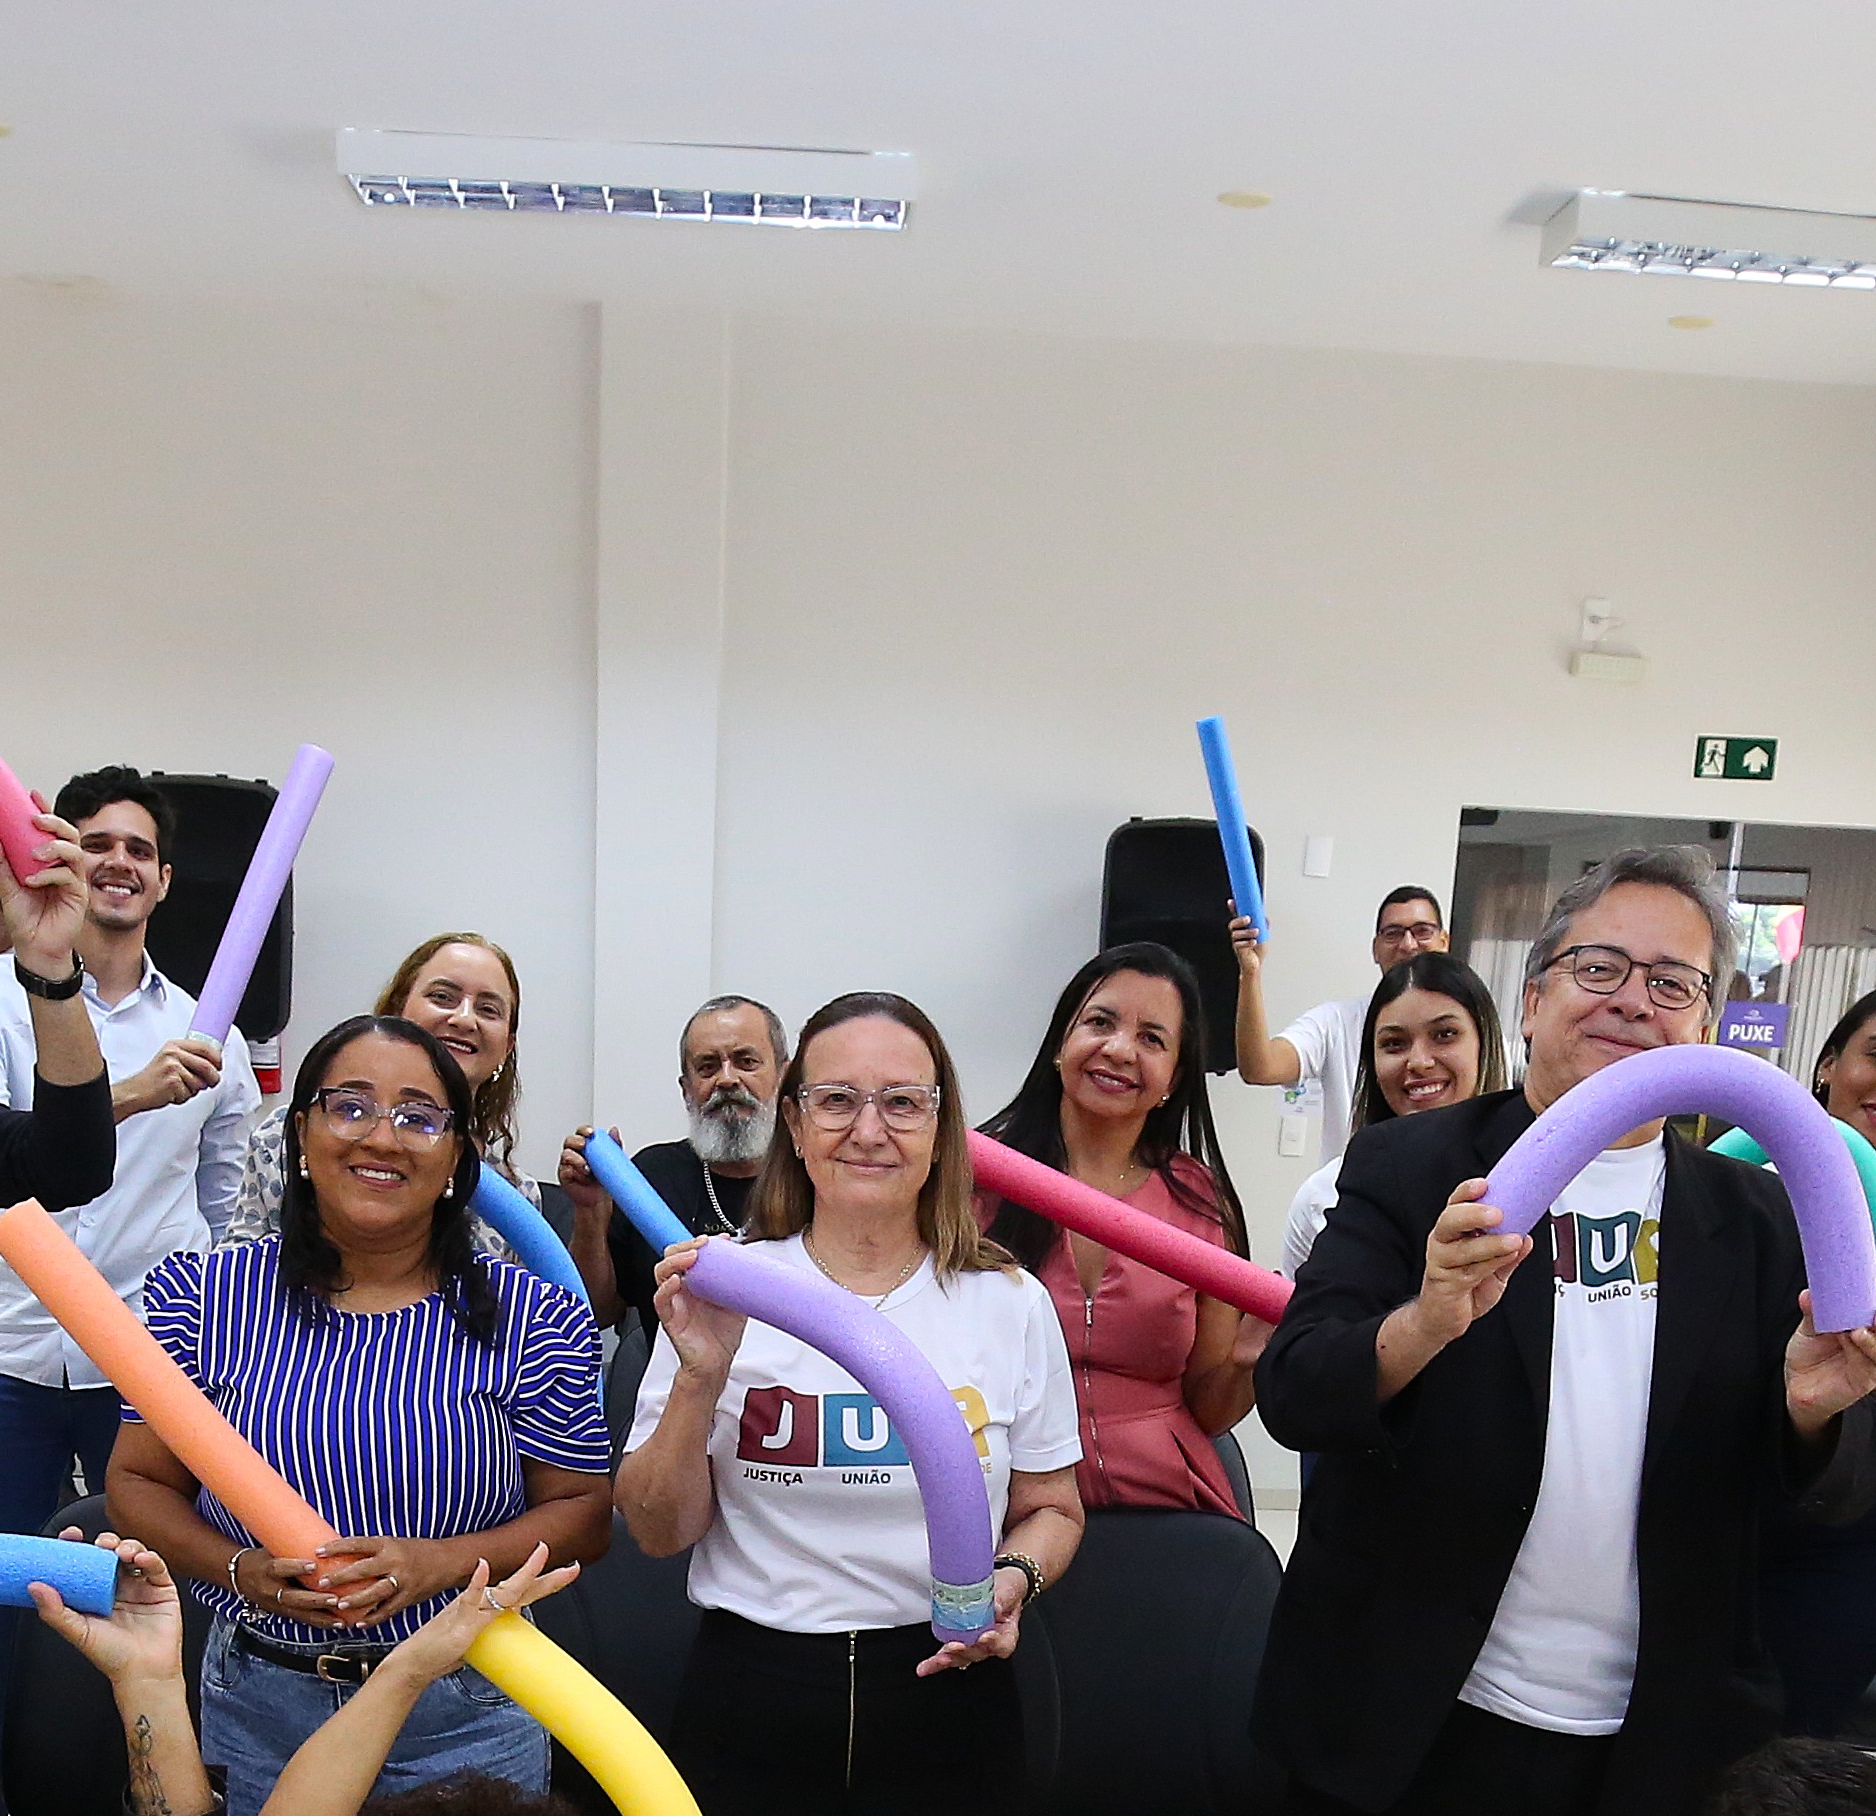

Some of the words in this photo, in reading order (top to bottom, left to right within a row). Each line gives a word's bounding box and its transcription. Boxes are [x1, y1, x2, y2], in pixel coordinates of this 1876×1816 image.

[1728, 1024, 1775, 1042] PUXE
[1587, 1284, 1632, 1303] UNIÃO
[743, 1467, 804, 1487] JUSTIÇA
[841, 1468, 892, 1485] UNIÃO
